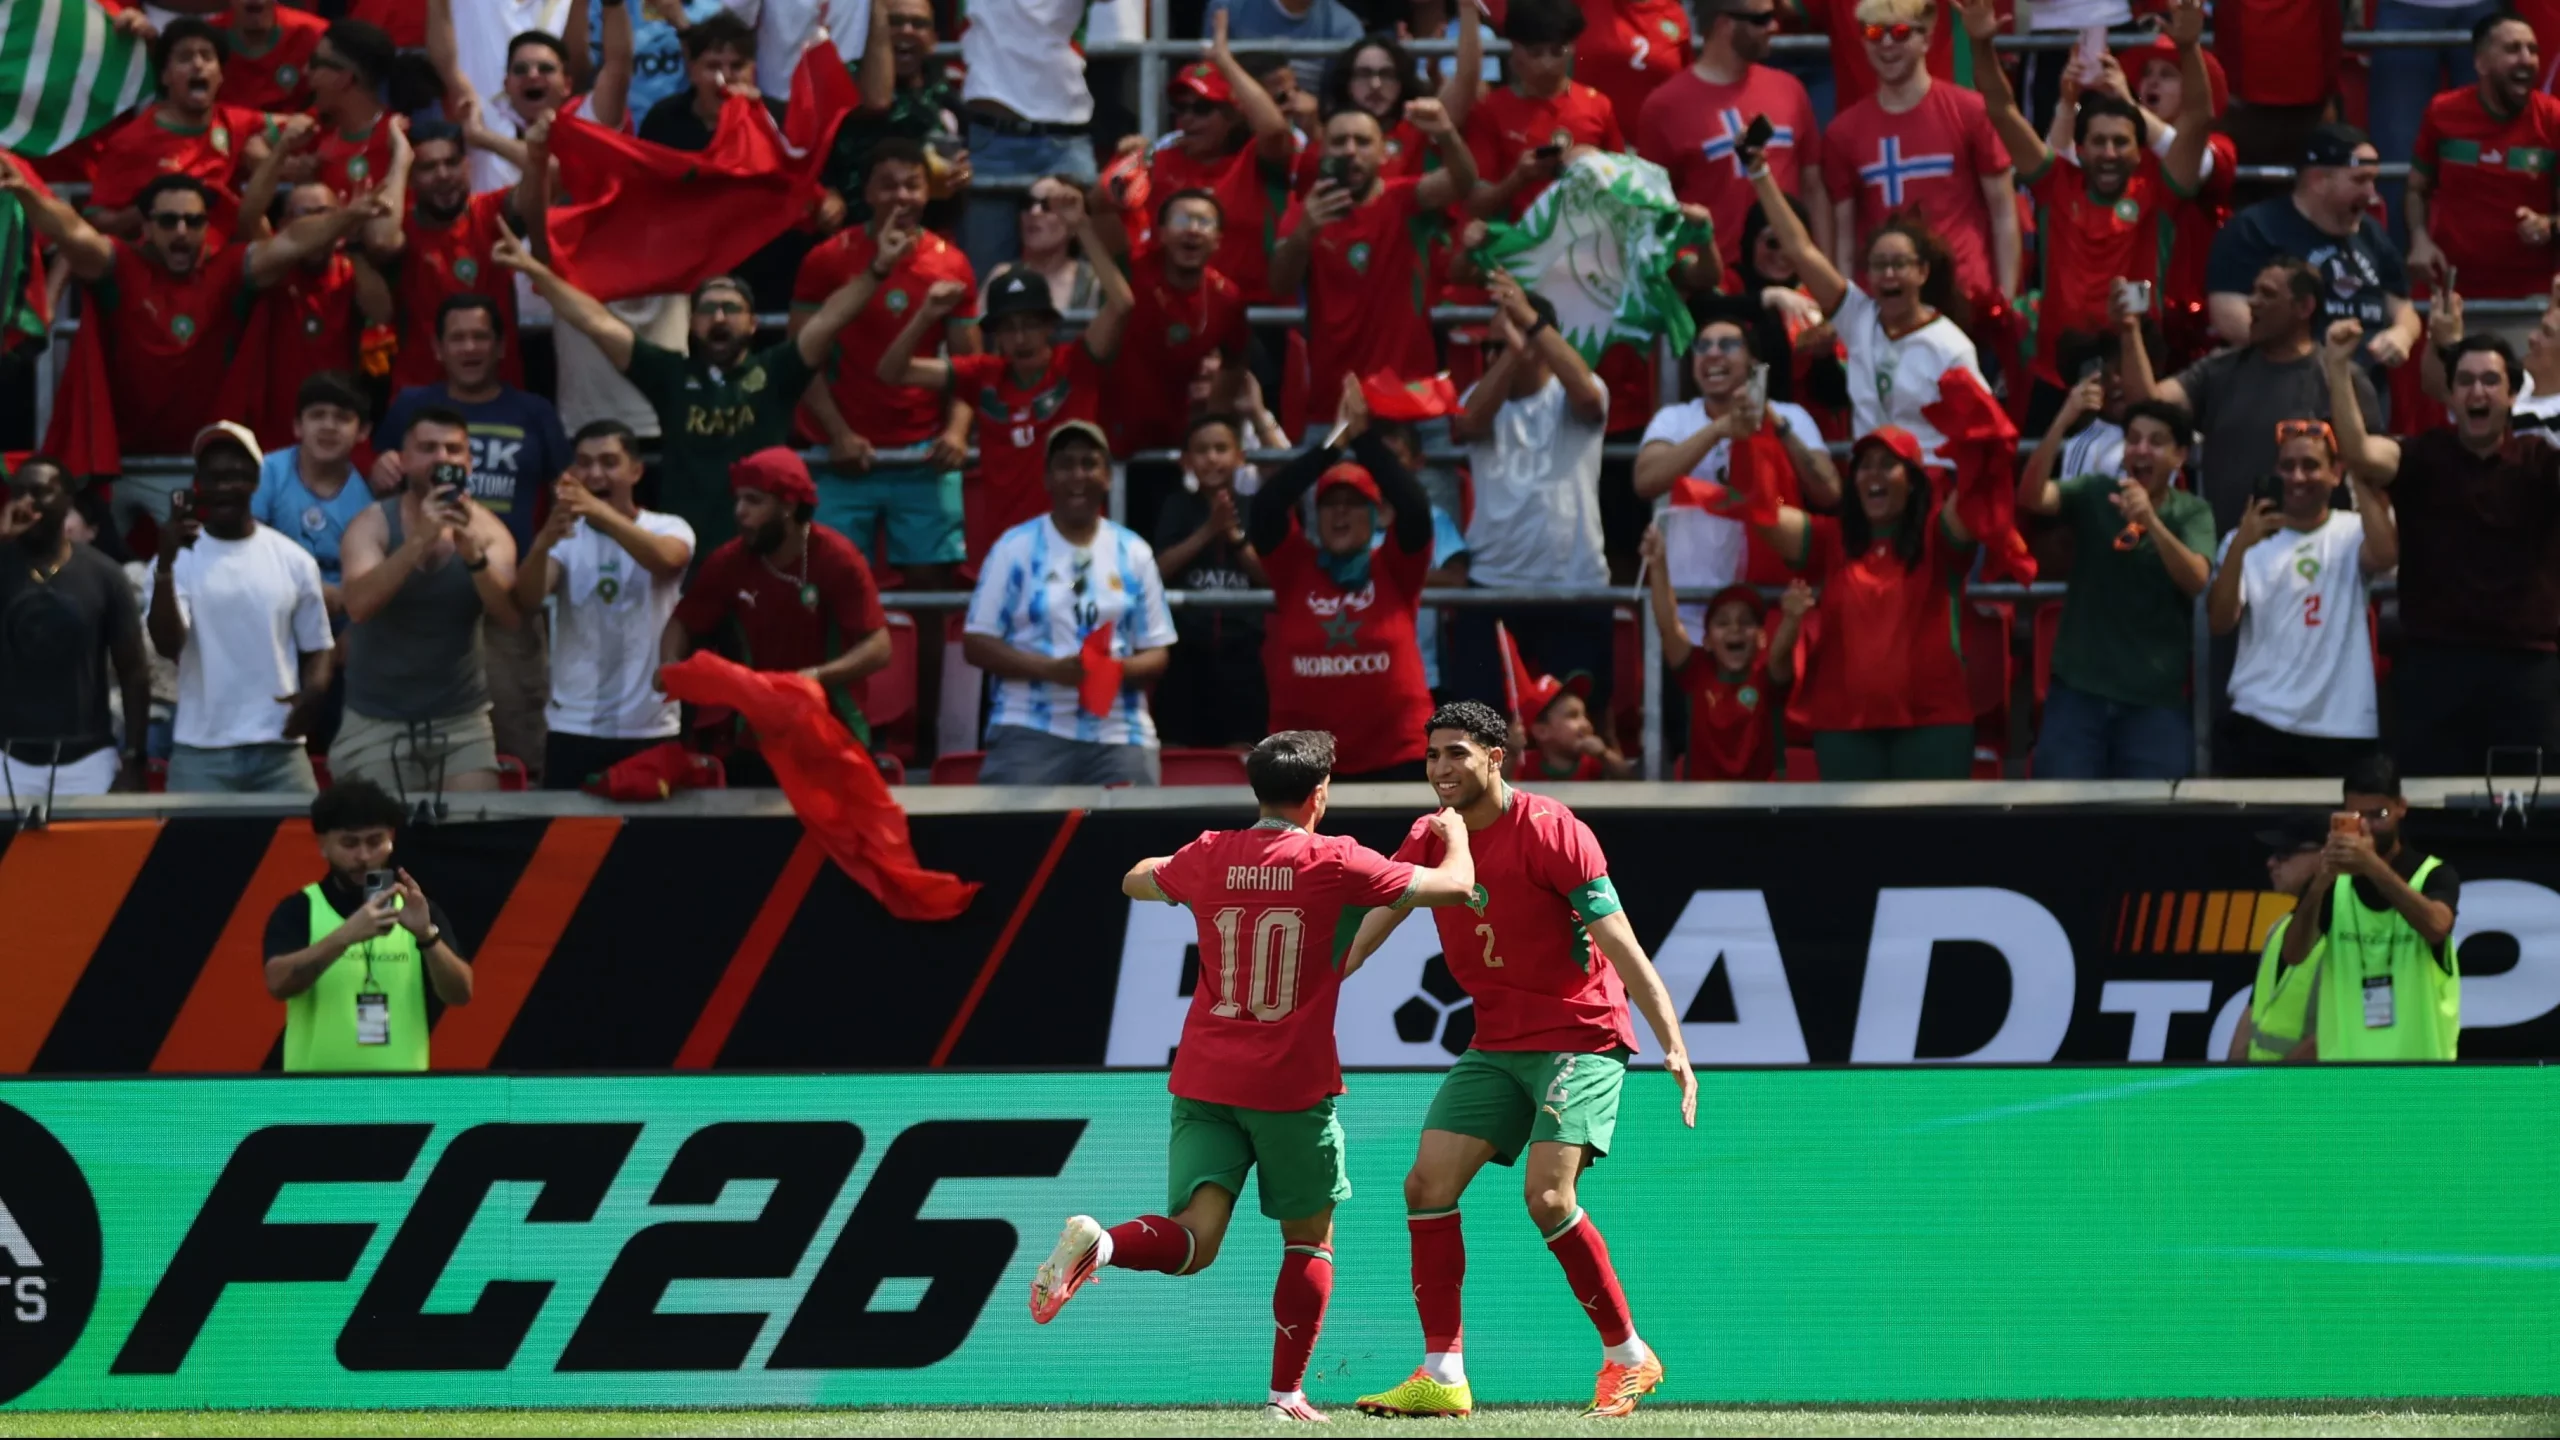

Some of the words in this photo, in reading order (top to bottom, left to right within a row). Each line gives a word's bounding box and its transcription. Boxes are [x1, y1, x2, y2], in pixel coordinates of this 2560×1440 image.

[1630, 35, 1650, 71] 2
[2303, 593, 2322, 628] 2
[1292, 652, 1390, 677] MOROCCO
[1226, 865, 1294, 892] BRAHIM
[1209, 906, 1306, 1024] 10
[1474, 923, 1505, 968] 2
[1545, 1052, 1577, 1102] 2
[107, 1117, 1090, 1376] FC26
